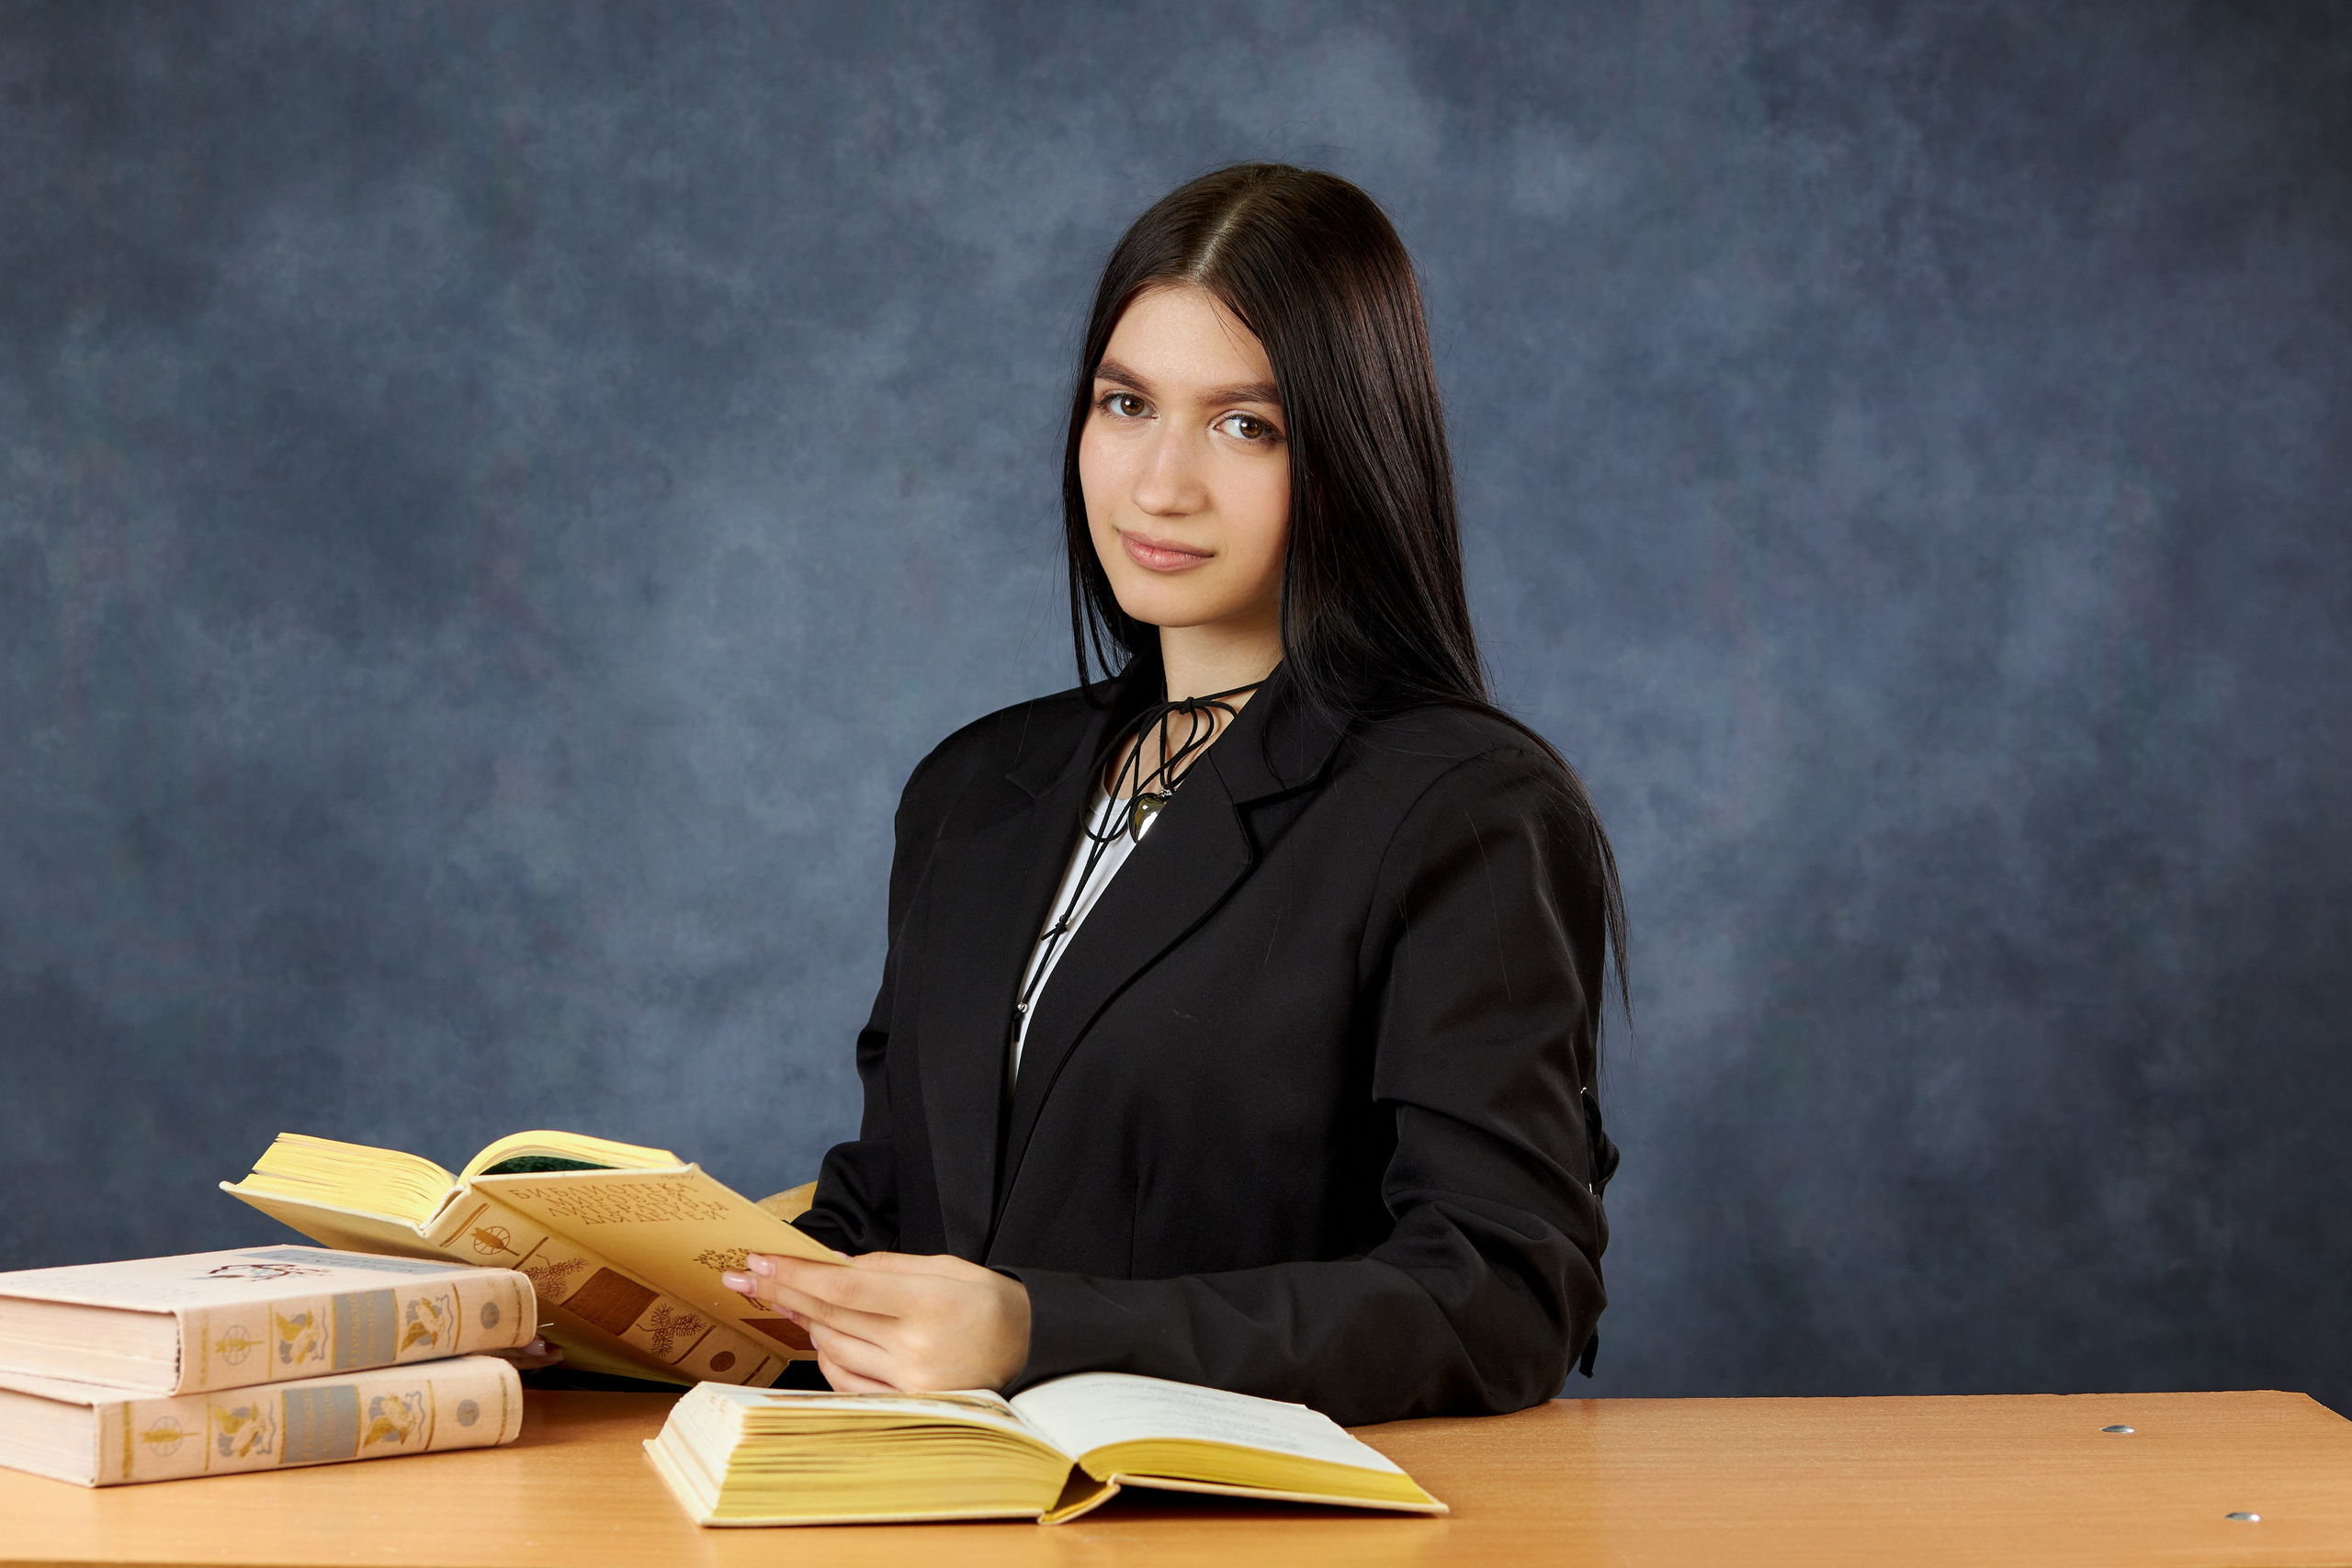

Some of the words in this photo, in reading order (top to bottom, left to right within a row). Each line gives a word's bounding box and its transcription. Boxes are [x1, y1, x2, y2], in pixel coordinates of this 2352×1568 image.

[508, 1182, 699, 1200] БИБЛИОТЕКА
[545, 1192, 693, 1207] МИРОВОЙ
[548, 1201, 730, 1217] ЛИТЕРАТУРЫ
[581, 1213, 631, 1225] ДЛЯ
[635, 1210, 728, 1223] ДЕТЕЙ
